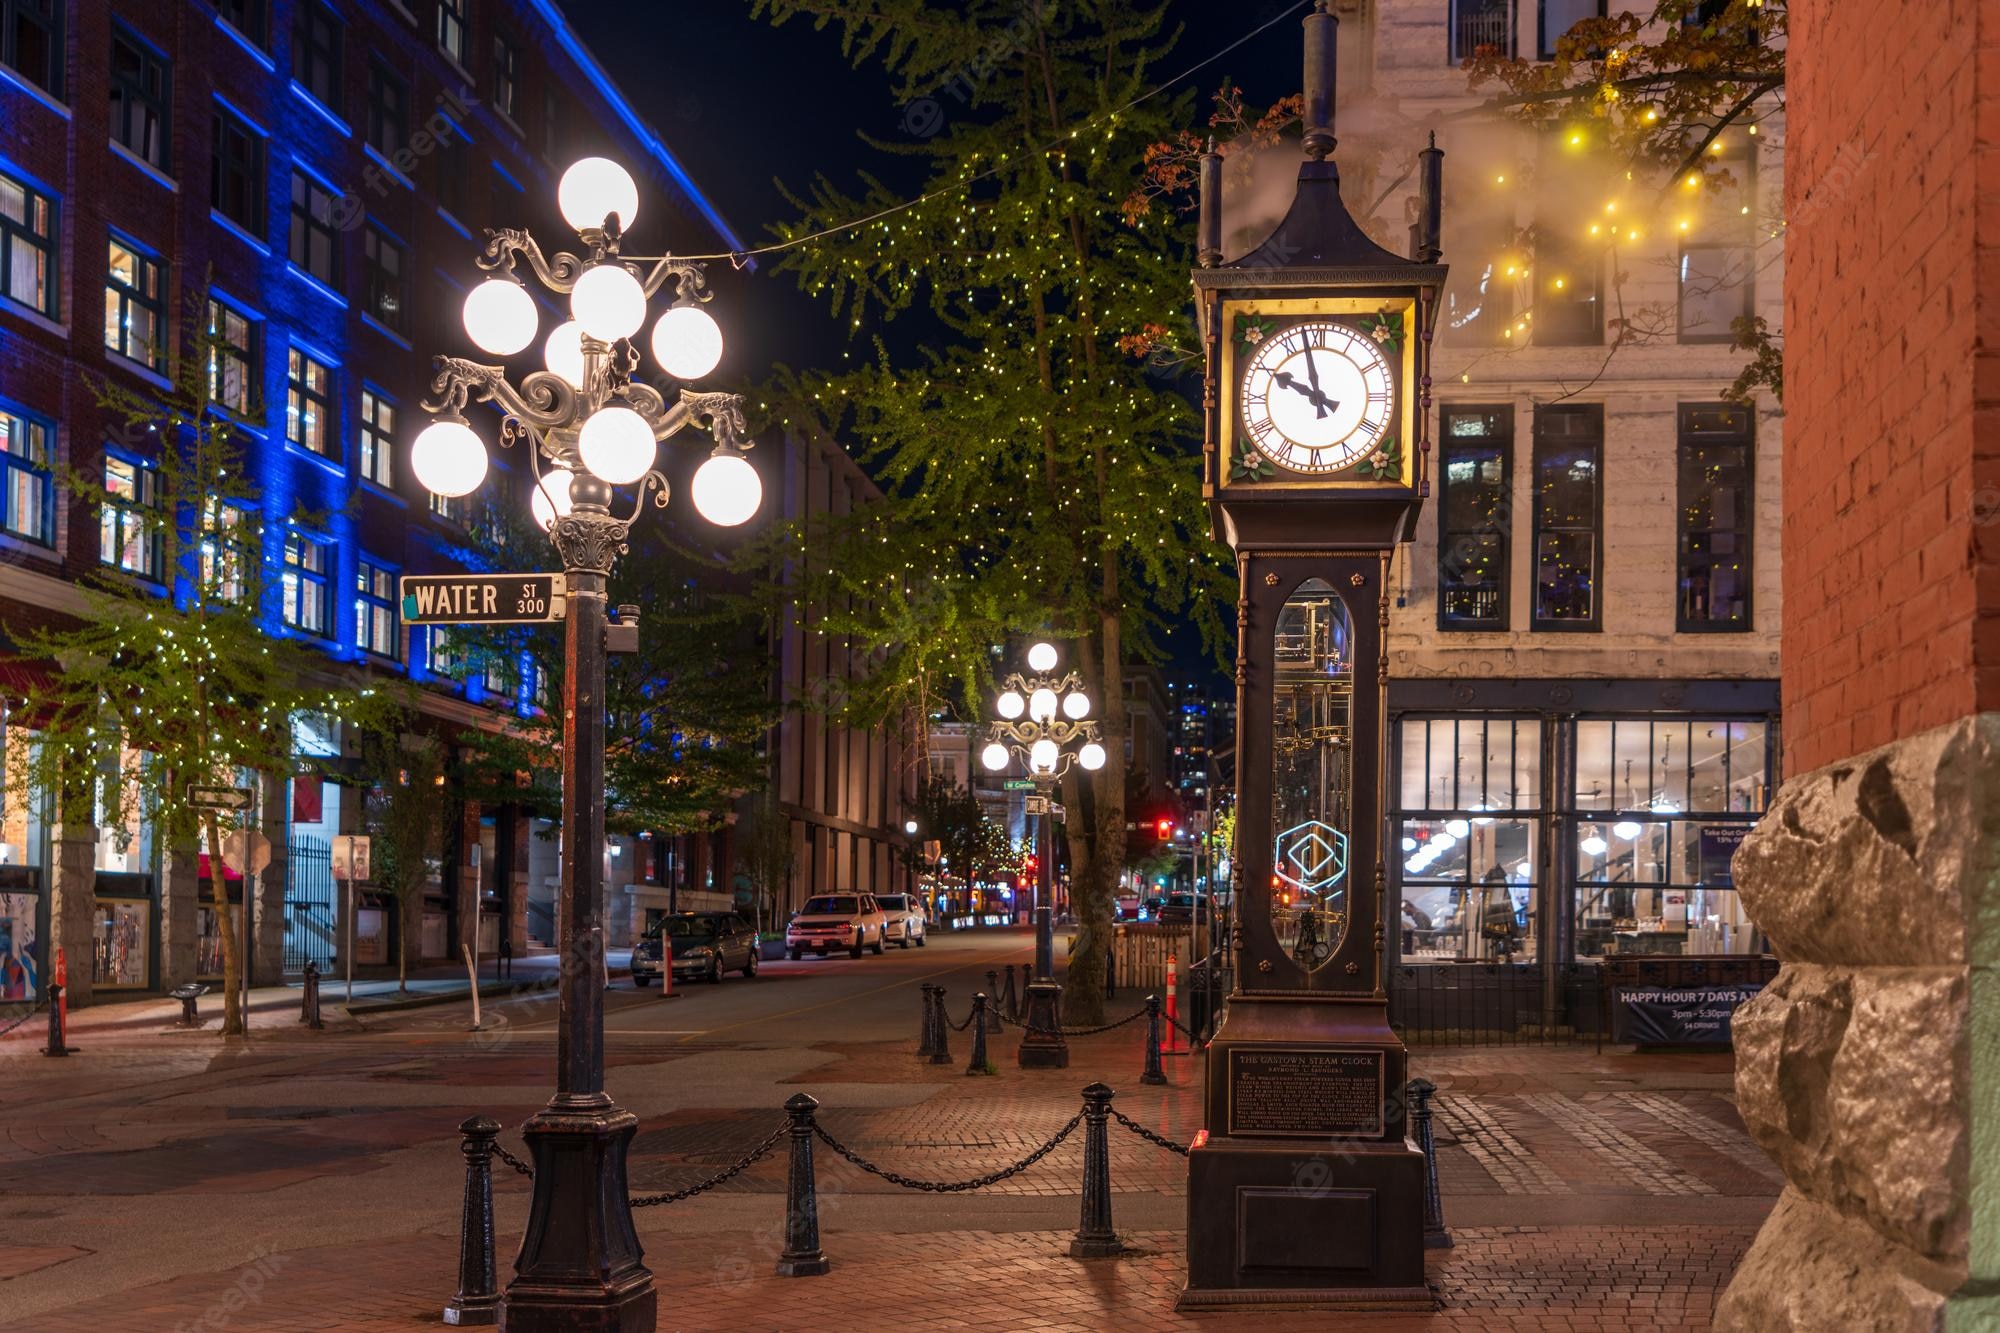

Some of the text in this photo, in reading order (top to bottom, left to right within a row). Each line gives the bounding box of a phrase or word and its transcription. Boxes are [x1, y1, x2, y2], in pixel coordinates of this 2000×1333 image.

[415, 584, 537, 615] WATER ST
[517, 599, 544, 614] 300
[1621, 992, 1660, 1003] HAPPY
[1662, 992, 1696, 1003] HOUR
[1698, 992, 1705, 1002] 7
[1707, 991, 1737, 1002] DAYS
[1739, 992, 1748, 1002] A
[1671, 1009, 1692, 1019] 3pm
[1699, 1009, 1731, 1019] 5:30pm
[1240, 1055, 1373, 1065] THE GASTOWN STEAM CLOCK
